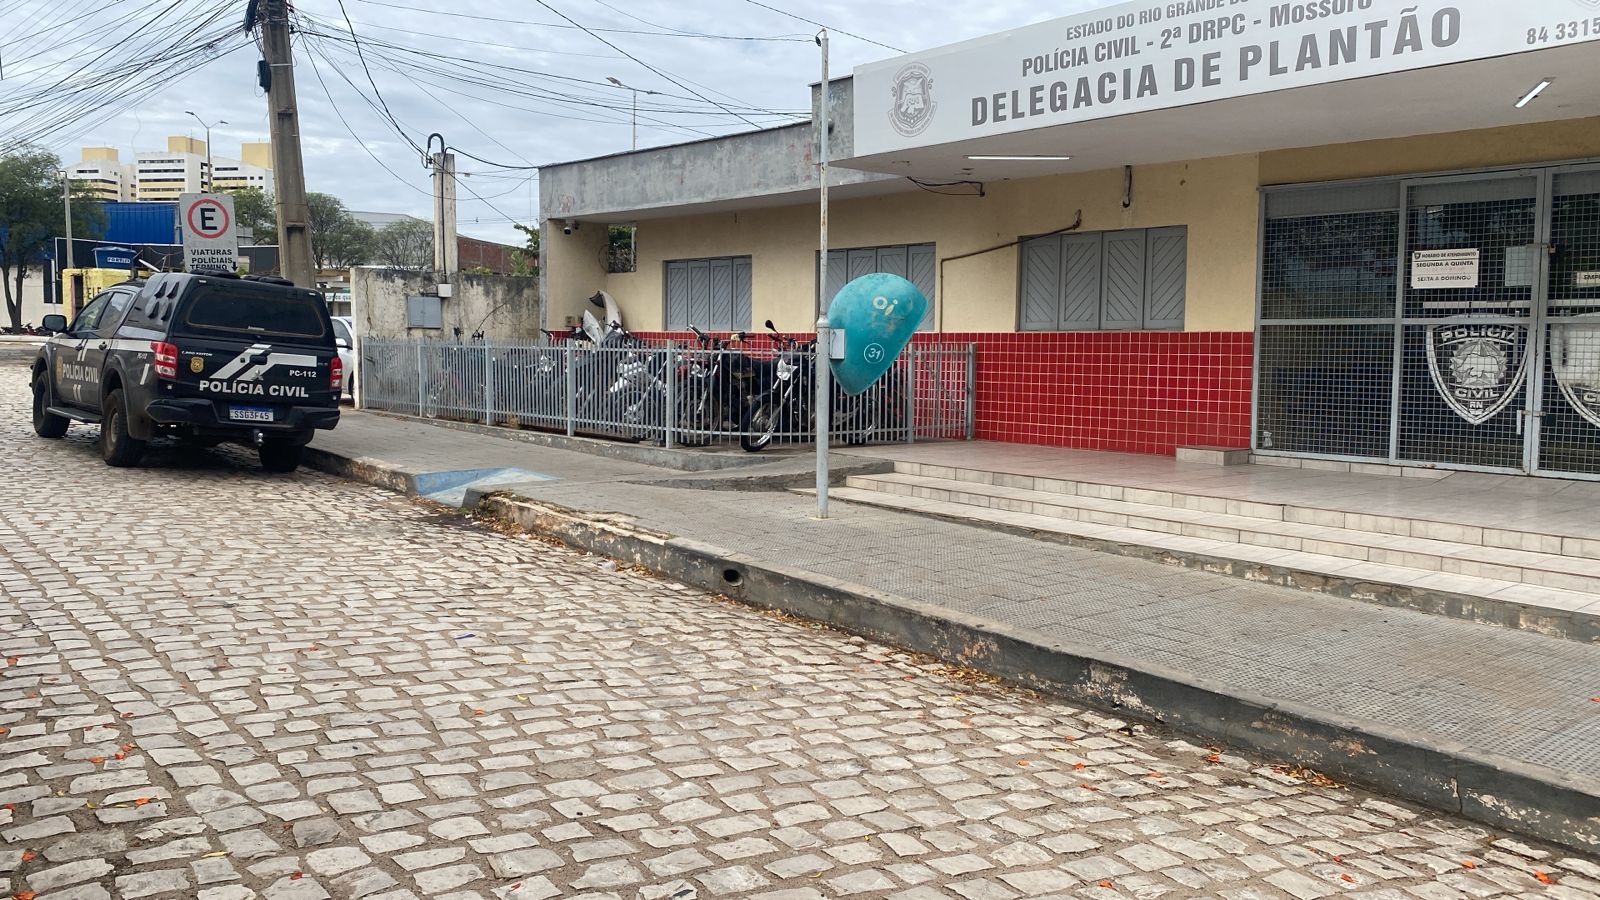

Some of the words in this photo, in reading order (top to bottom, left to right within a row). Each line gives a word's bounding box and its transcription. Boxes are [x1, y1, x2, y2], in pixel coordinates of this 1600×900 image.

[1066, 18, 1113, 40] ESTADO
[1117, 13, 1135, 30] DO
[1139, 7, 1162, 25] RIO
[1166, 0, 1225, 18] GRANDE
[1526, 26, 1548, 45] 84
[1556, 17, 1600, 40] 3315
[1022, 46, 1089, 77] POLÍCIA
[1094, 36, 1141, 63] CIVIL
[1188, 13, 1246, 44] DRPC
[971, 64, 1159, 127] DELEGACIA
[1174, 52, 1222, 92] DE
[1239, 6, 1461, 81] PLANTÃO
[200, 208, 217, 230] E
[868, 347, 881, 360] 31
[62, 361, 84, 380] POLÍCIA
[84, 366, 99, 383] CIVIL
[289, 369, 317, 378] PC-112
[199, 379, 265, 396] POLÍCIA
[268, 385, 309, 398] CIVIL
[1454, 388, 1500, 398] CIVIL
[234, 410, 270, 420] SSG3F45
[1469, 401, 1483, 409] RN
